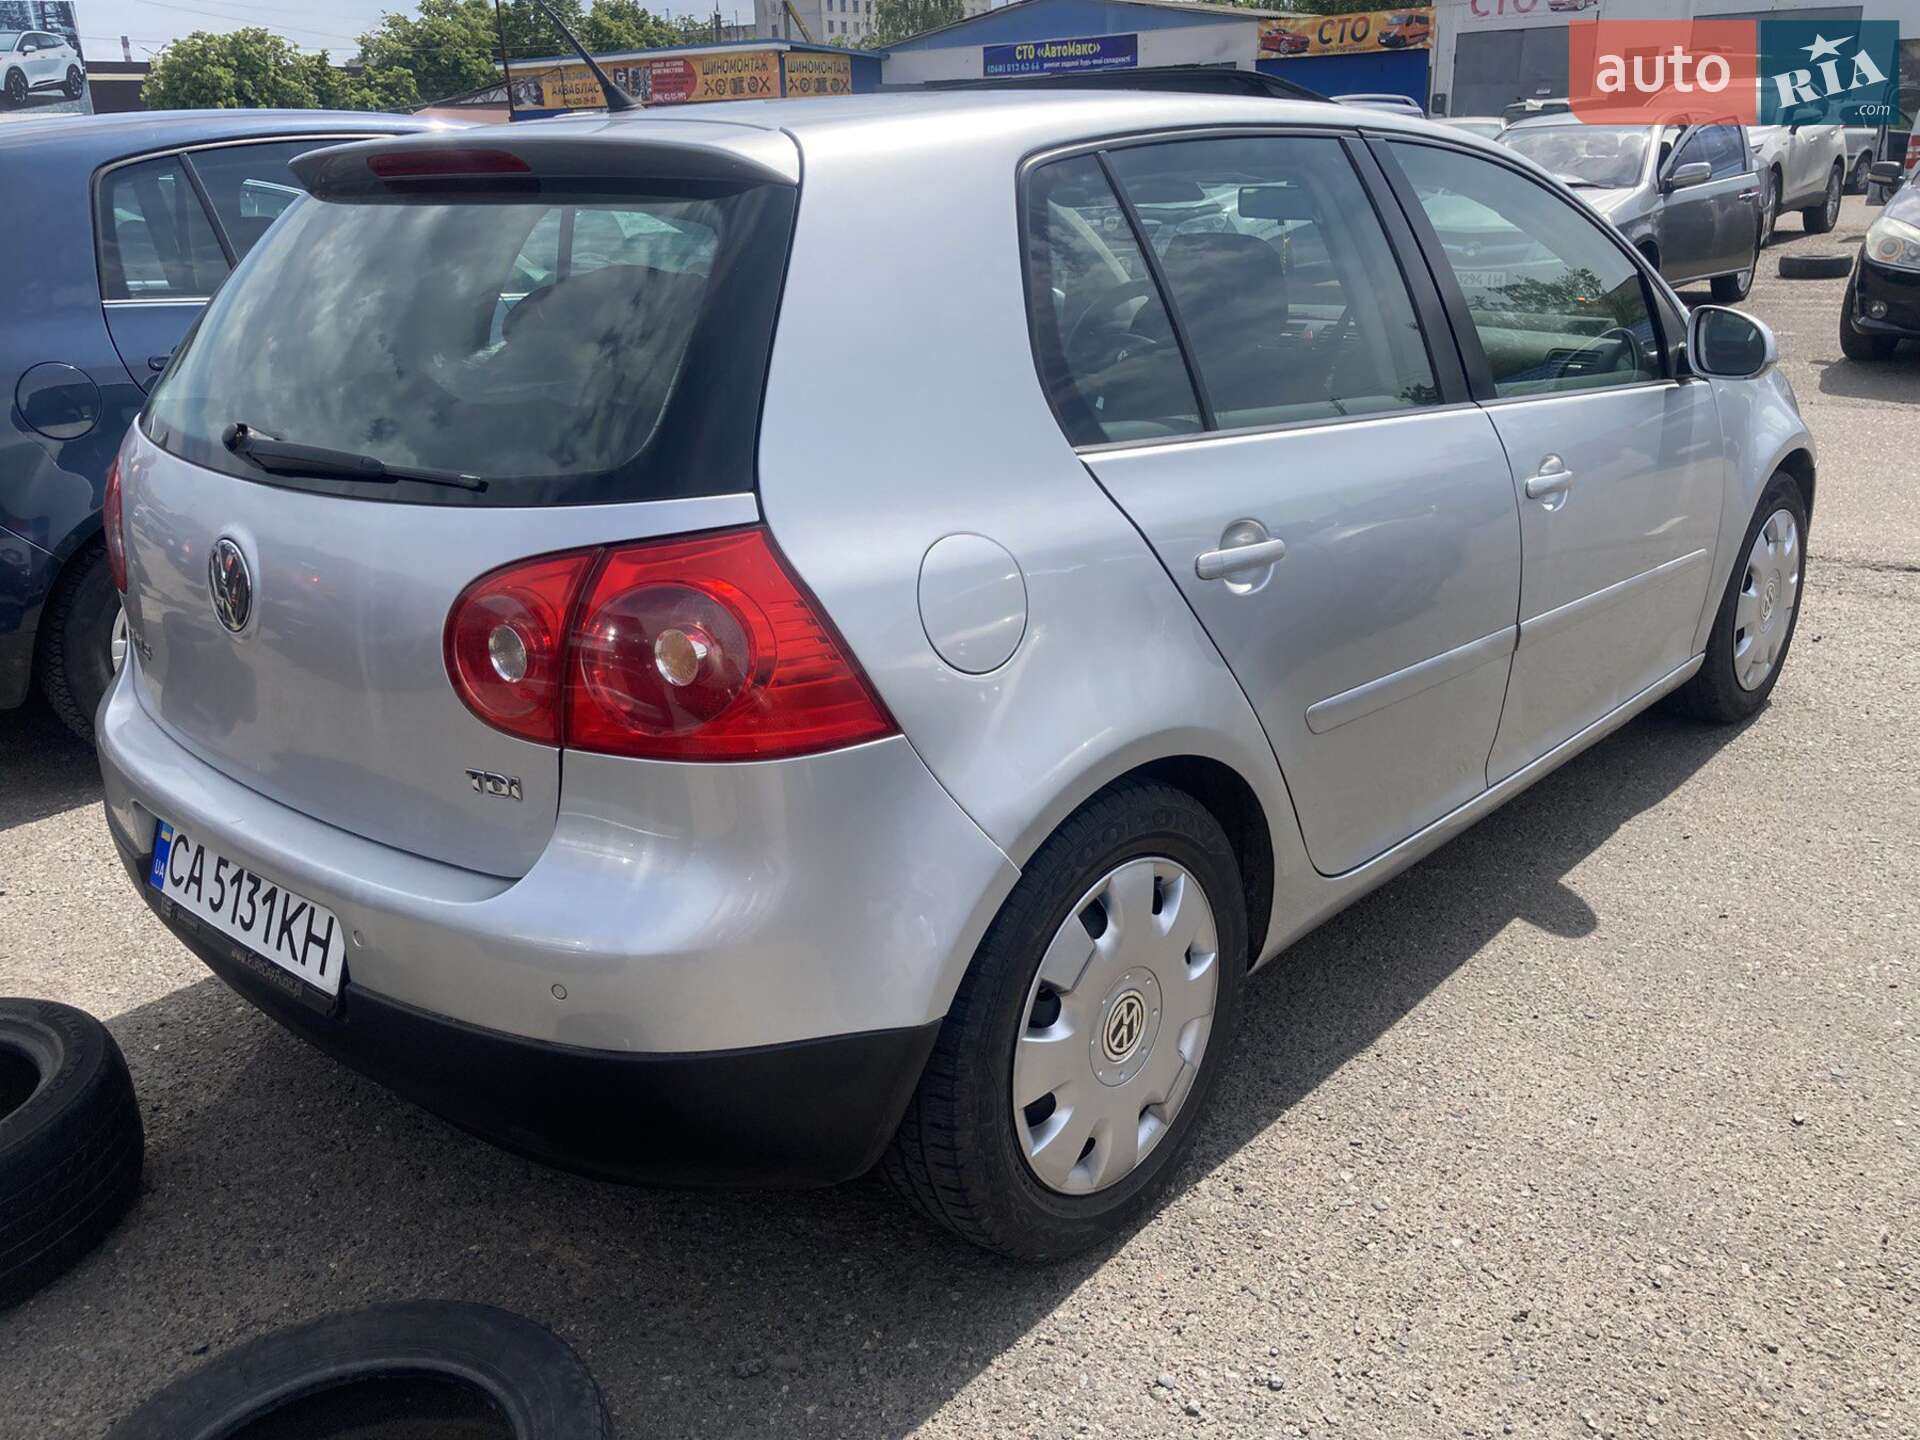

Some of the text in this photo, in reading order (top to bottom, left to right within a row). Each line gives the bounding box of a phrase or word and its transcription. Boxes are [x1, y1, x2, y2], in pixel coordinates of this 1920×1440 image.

[1318, 16, 1370, 44] СТО
[1015, 44, 1035, 60] СТО
[703, 58, 768, 75] ШИНОМОНТАЖ
[787, 59, 849, 74] ШИНОМОНТАЖ
[552, 82, 600, 97] АКВАБЛАС
[464, 768, 523, 801] TDI
[154, 859, 164, 879] UA
[169, 834, 205, 903] CA
[209, 856, 278, 945] 5131
[276, 893, 335, 976] KH
